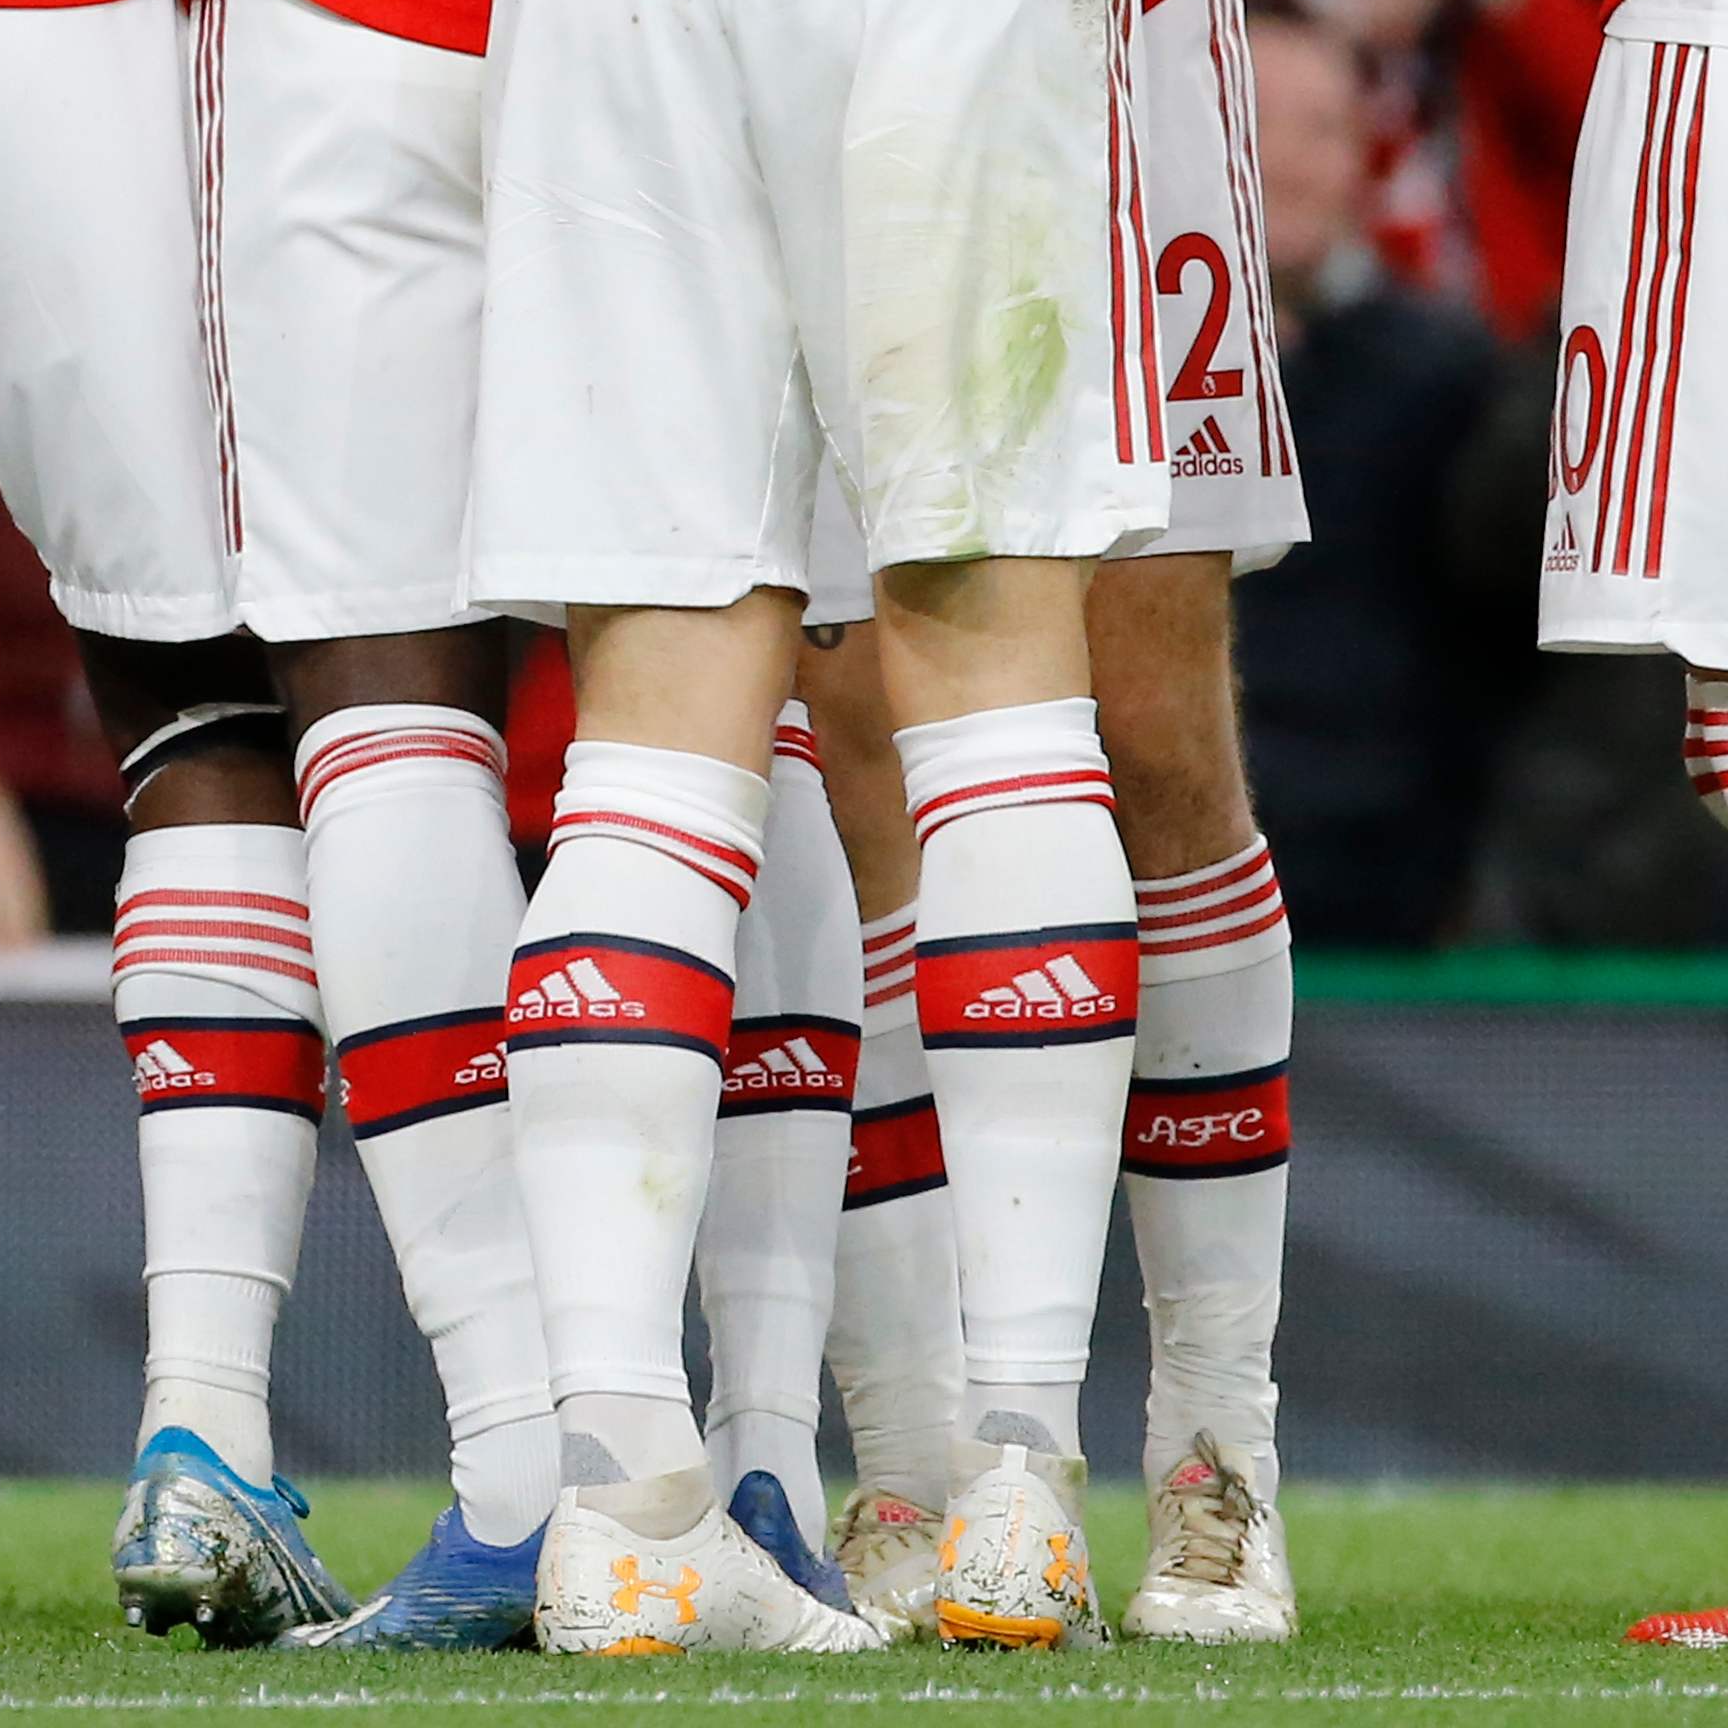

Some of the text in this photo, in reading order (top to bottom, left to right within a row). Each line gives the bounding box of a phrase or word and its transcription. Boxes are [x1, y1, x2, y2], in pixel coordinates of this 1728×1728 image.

[1156, 232, 1245, 401] 2
[1170, 453, 1245, 479] adidas
[508, 994, 645, 1023] adidas
[962, 992, 1117, 1020] adidas
[724, 1068, 844, 1092] adidas
[1136, 1108, 1266, 1149] AFC
